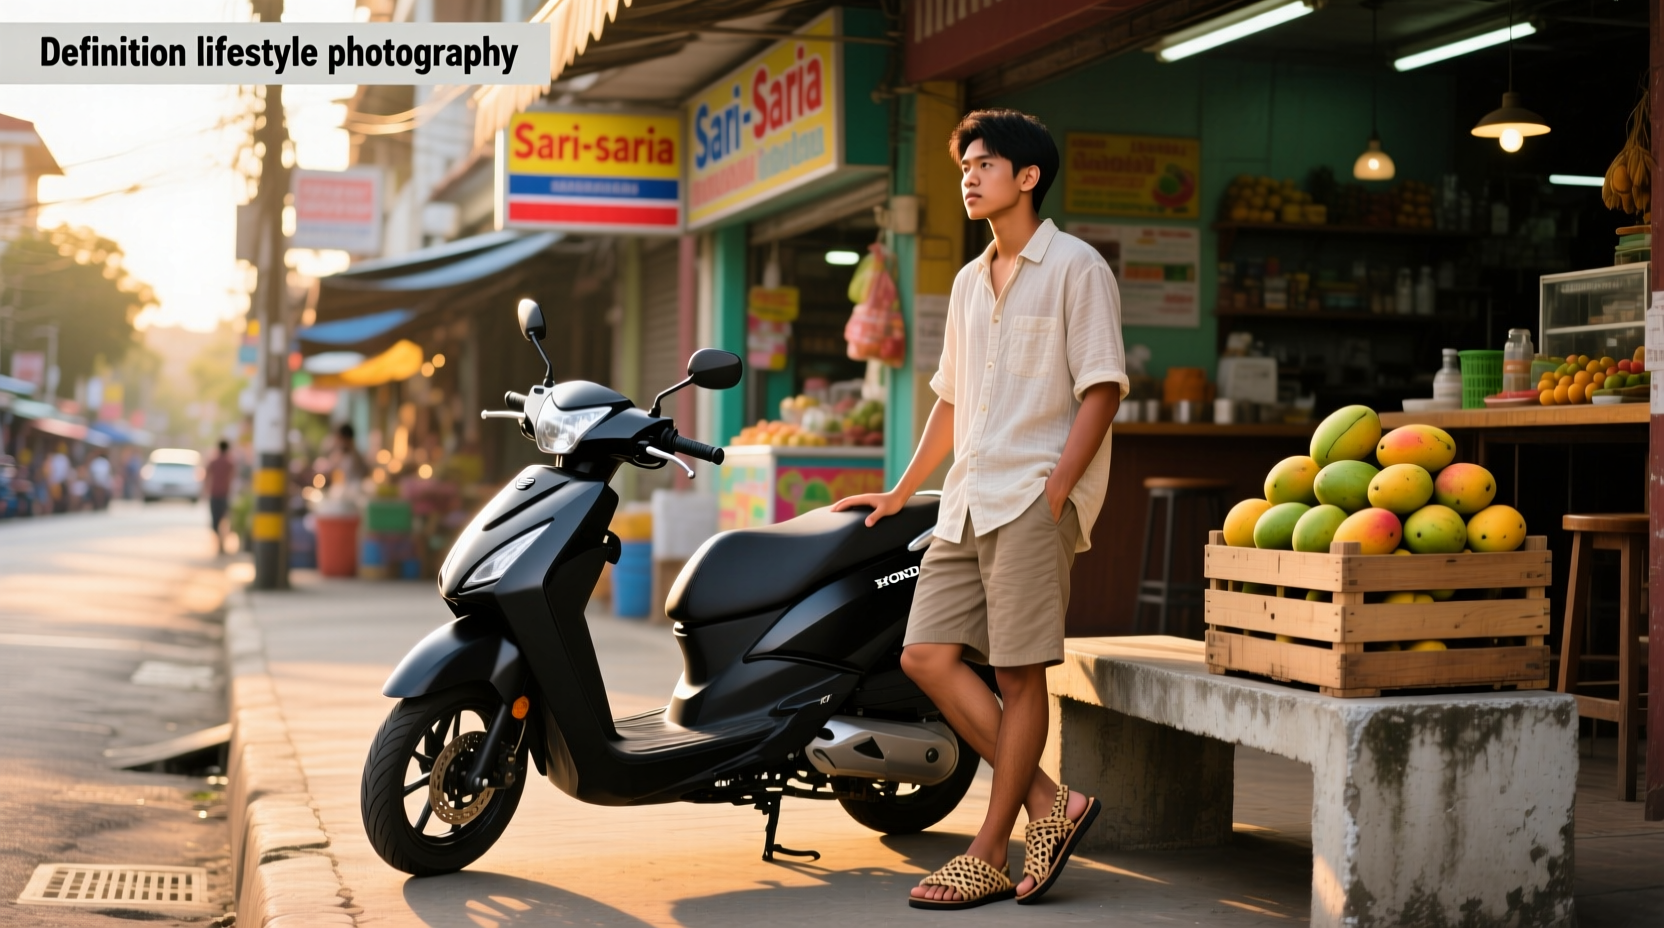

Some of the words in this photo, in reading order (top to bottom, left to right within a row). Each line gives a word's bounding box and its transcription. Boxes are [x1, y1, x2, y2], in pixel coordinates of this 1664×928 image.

[694, 45, 823, 170] Sari-Saria
[514, 121, 675, 166] Sari-saria
[874, 565, 920, 589] HOND
